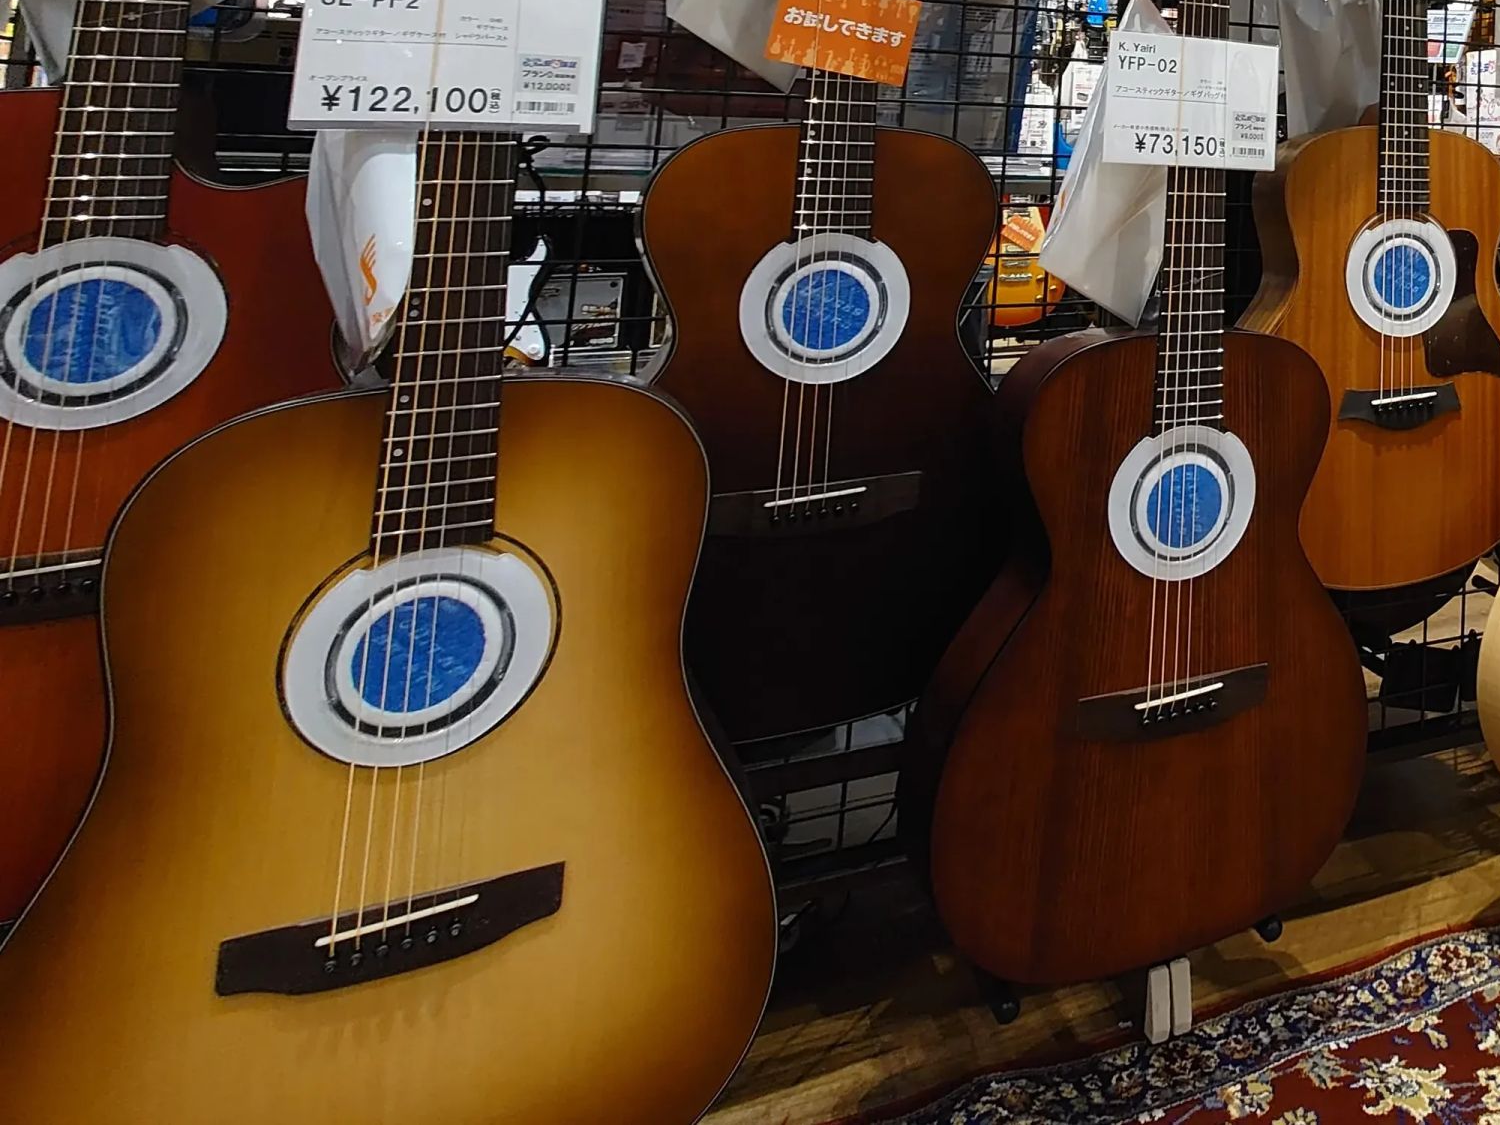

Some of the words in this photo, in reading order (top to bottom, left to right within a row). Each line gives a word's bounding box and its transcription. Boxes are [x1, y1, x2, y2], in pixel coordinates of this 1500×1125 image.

[783, 6, 907, 48] お試しできます
[1118, 41, 1130, 52] K.
[1133, 42, 1157, 53] Yairi
[1118, 54, 1178, 74] YFP-02
[321, 83, 488, 115] ¥122,100
[1135, 132, 1218, 157] ¥73,150
